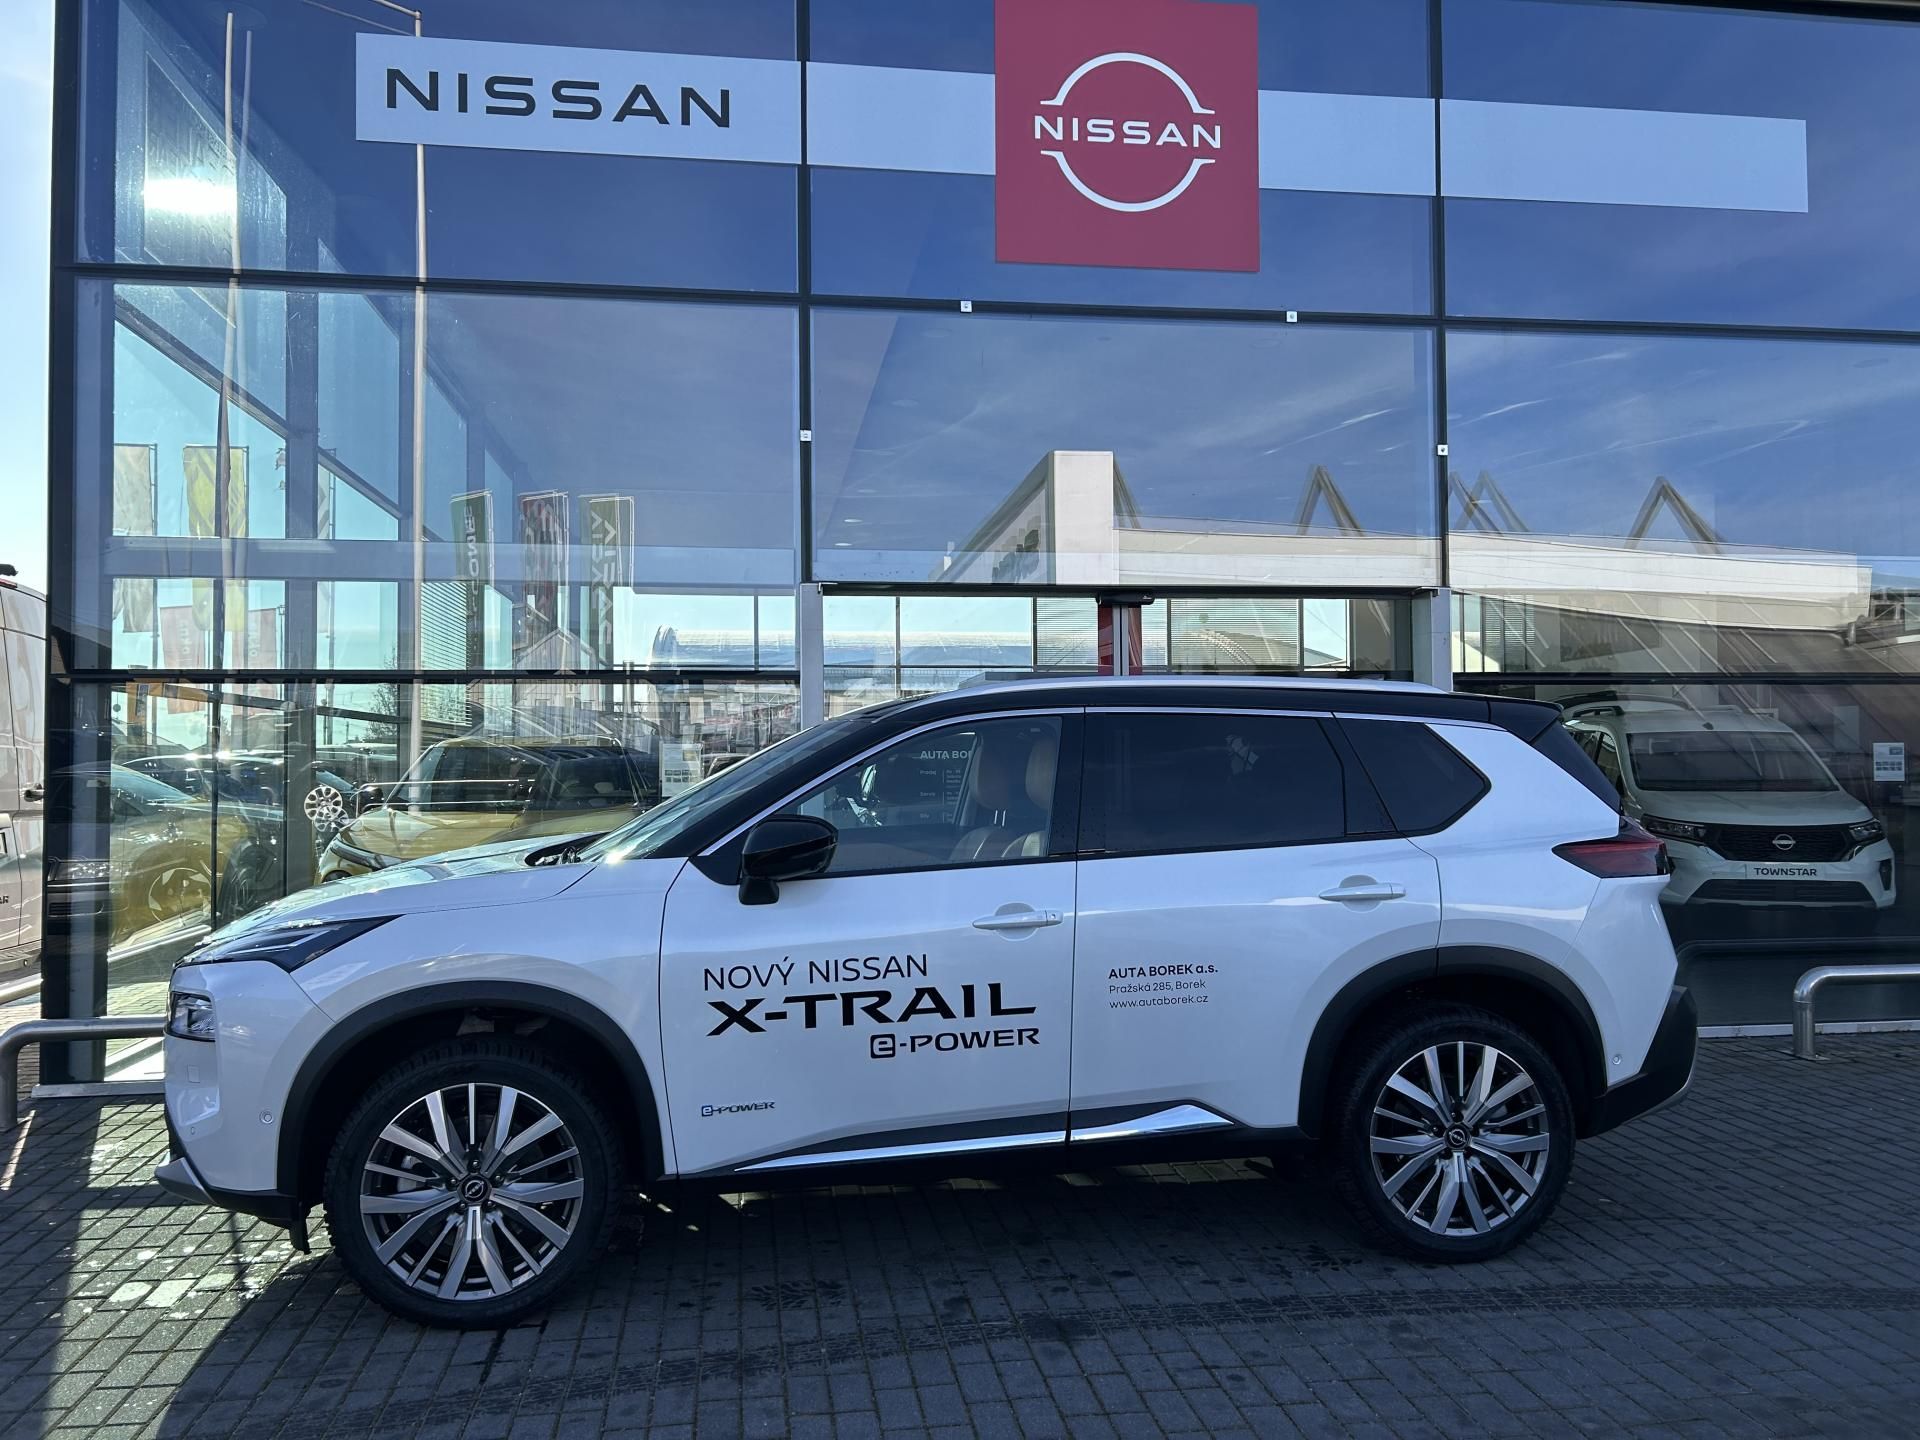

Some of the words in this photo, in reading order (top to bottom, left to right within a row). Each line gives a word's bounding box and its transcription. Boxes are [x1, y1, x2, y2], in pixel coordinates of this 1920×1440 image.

[386, 68, 731, 129] NISSAN
[1034, 115, 1221, 149] NISSAN
[920, 750, 950, 759] AUTA
[1754, 867, 1817, 876] TOWNSTAR
[704, 957, 795, 991] NOVÝ
[808, 954, 928, 984] NISSAN
[1109, 967, 1146, 979] AUTA
[1149, 964, 1193, 976] BOREK
[1196, 964, 1218, 974] a.s.
[1109, 984, 1151, 994] Pražská
[1153, 982, 1174, 992] 285,
[1175, 979, 1206, 990] Borek
[1109, 995, 1208, 1008] www.autaborek.cz
[706, 983, 1037, 1036] X-TRAIL
